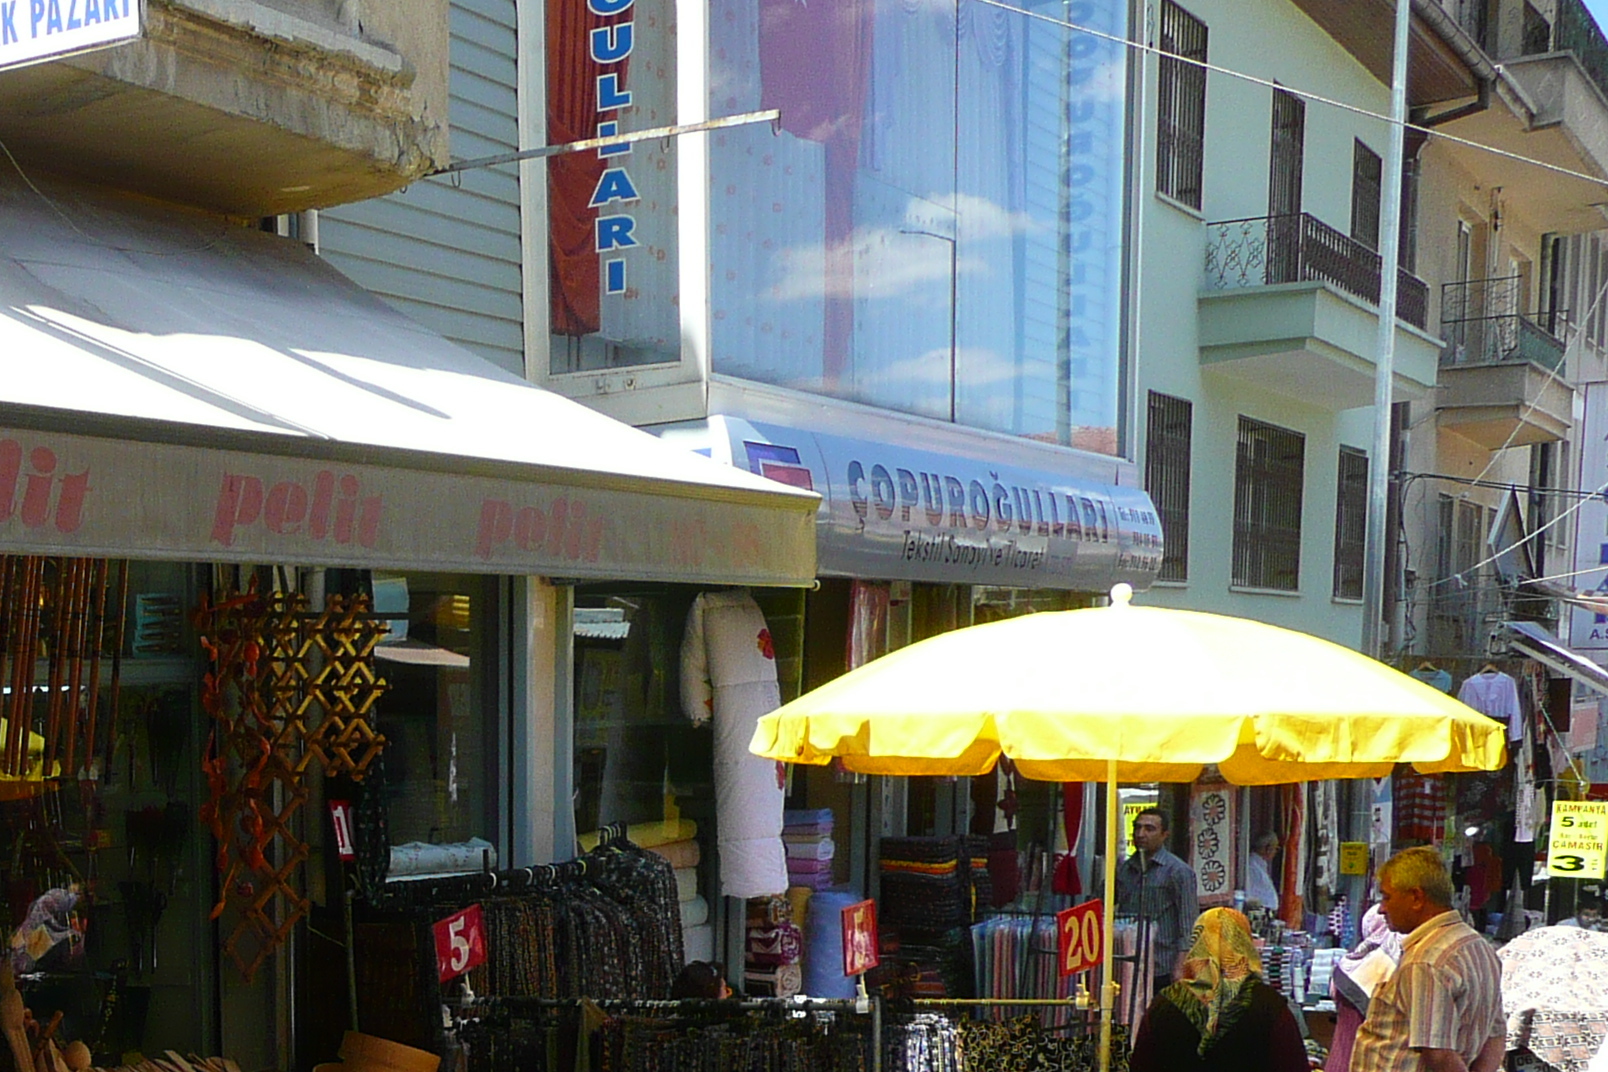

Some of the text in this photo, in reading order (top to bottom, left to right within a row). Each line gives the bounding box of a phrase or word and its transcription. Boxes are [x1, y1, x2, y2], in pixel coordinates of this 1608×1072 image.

[209, 469, 383, 547] pelit
[847, 461, 1108, 544] ÇOPUROĞULLARI
[901, 530, 944, 564] Tekstil
[1560, 816, 1575, 828] 5
[1552, 855, 1585, 872] 3
[449, 915, 470, 972] 5
[1064, 910, 1100, 970] 20
